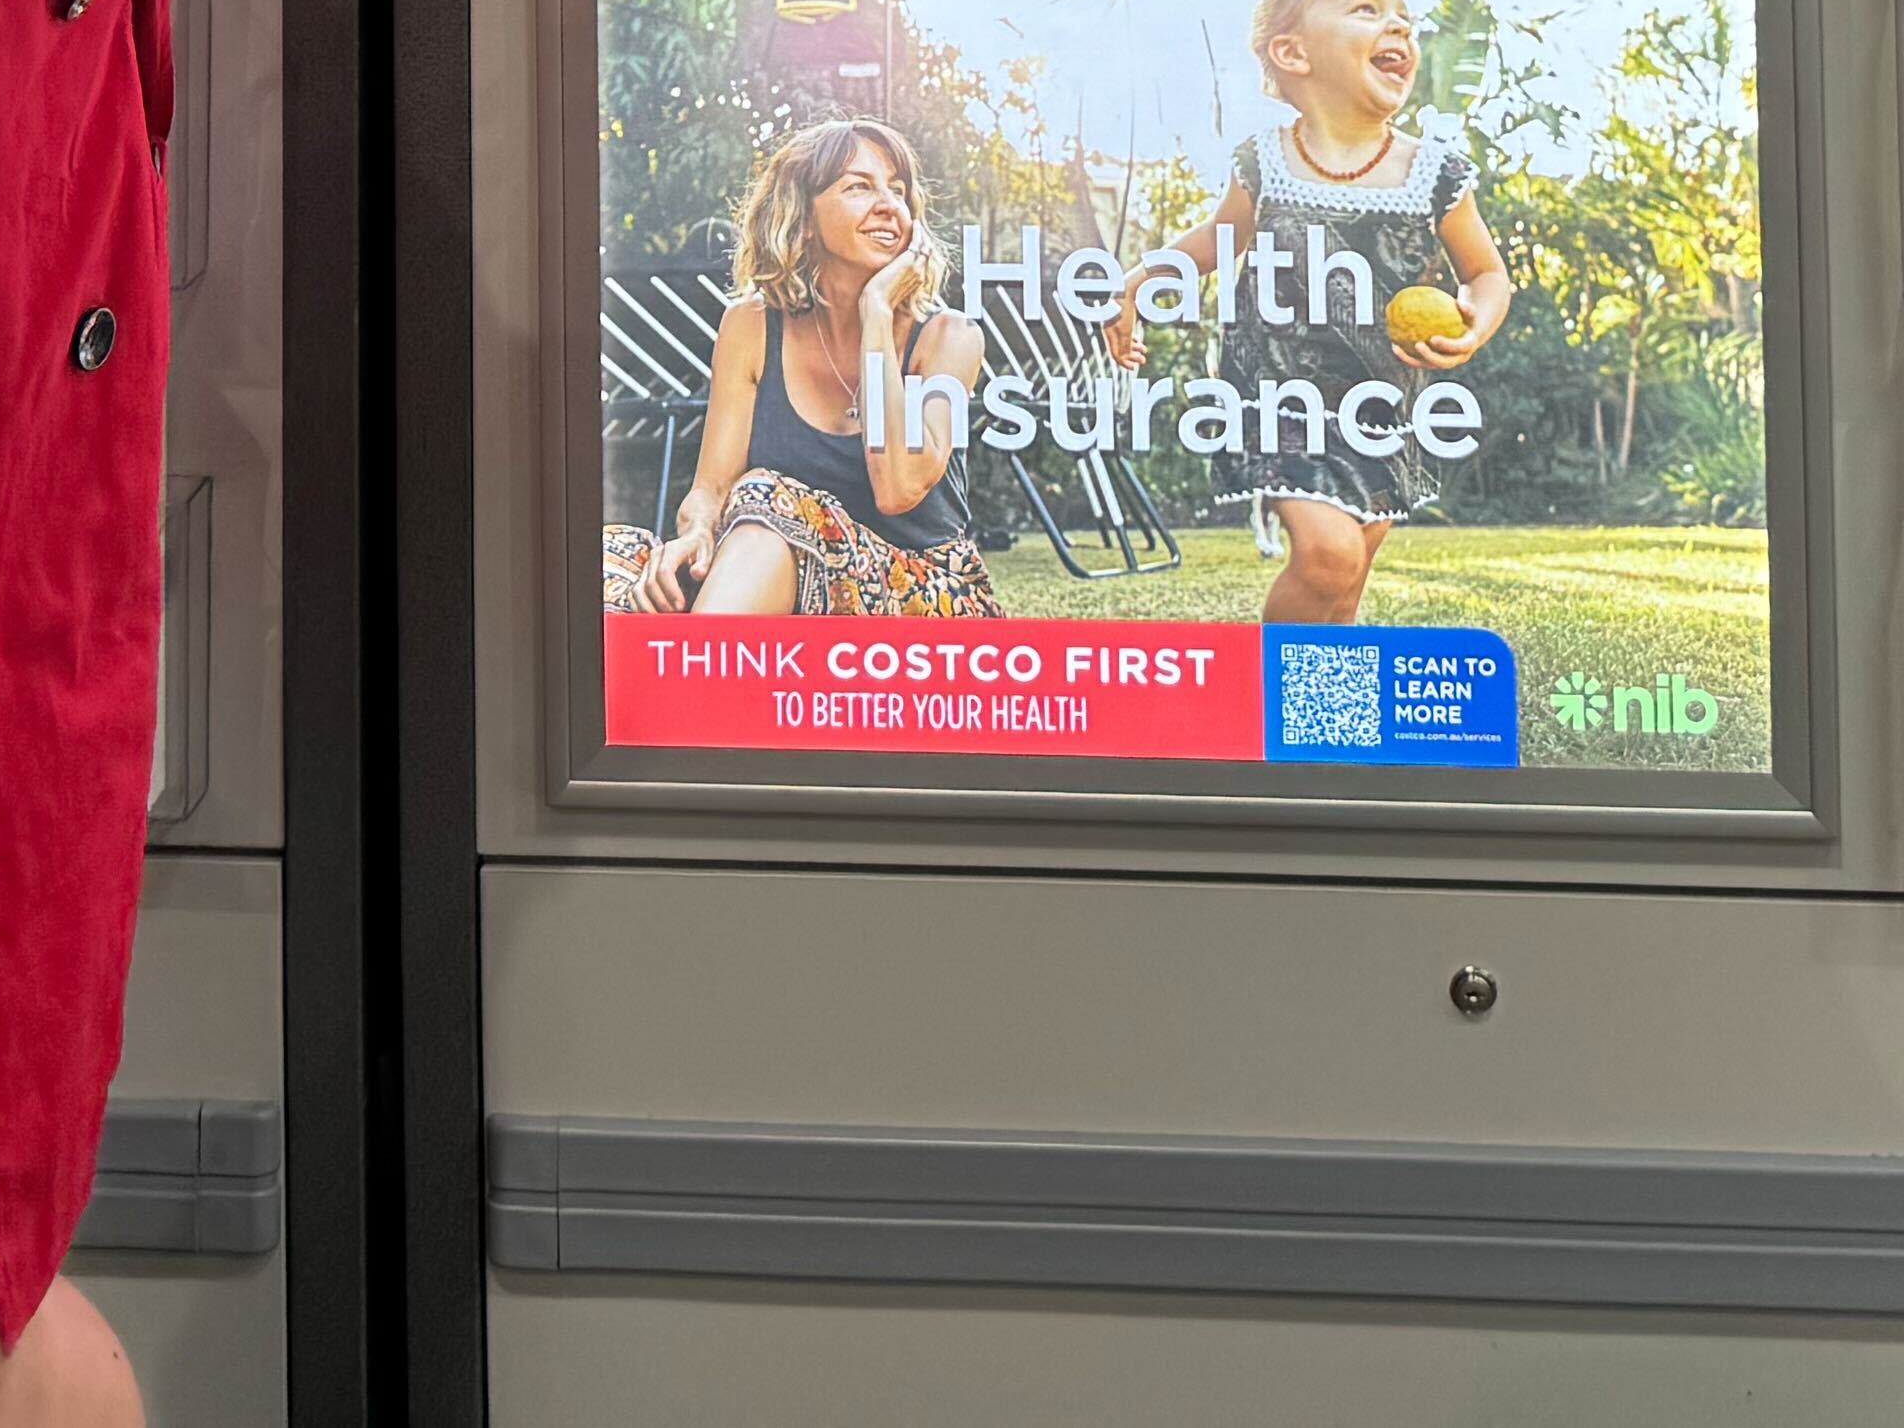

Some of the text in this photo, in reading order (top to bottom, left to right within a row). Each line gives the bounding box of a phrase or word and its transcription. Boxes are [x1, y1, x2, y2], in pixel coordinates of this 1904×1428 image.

[963, 222, 1373, 326] Health
[864, 353, 1483, 459] Insurance
[649, 641, 1215, 687] THINK COSTCO FIRST
[1395, 656, 1496, 676] SCAN TO
[1395, 679, 1472, 699] LEARN
[1612, 674, 1718, 733] nib
[773, 692, 1087, 732] TO BETTER YOUR HEALTH
[1395, 703, 1461, 723] MORE
